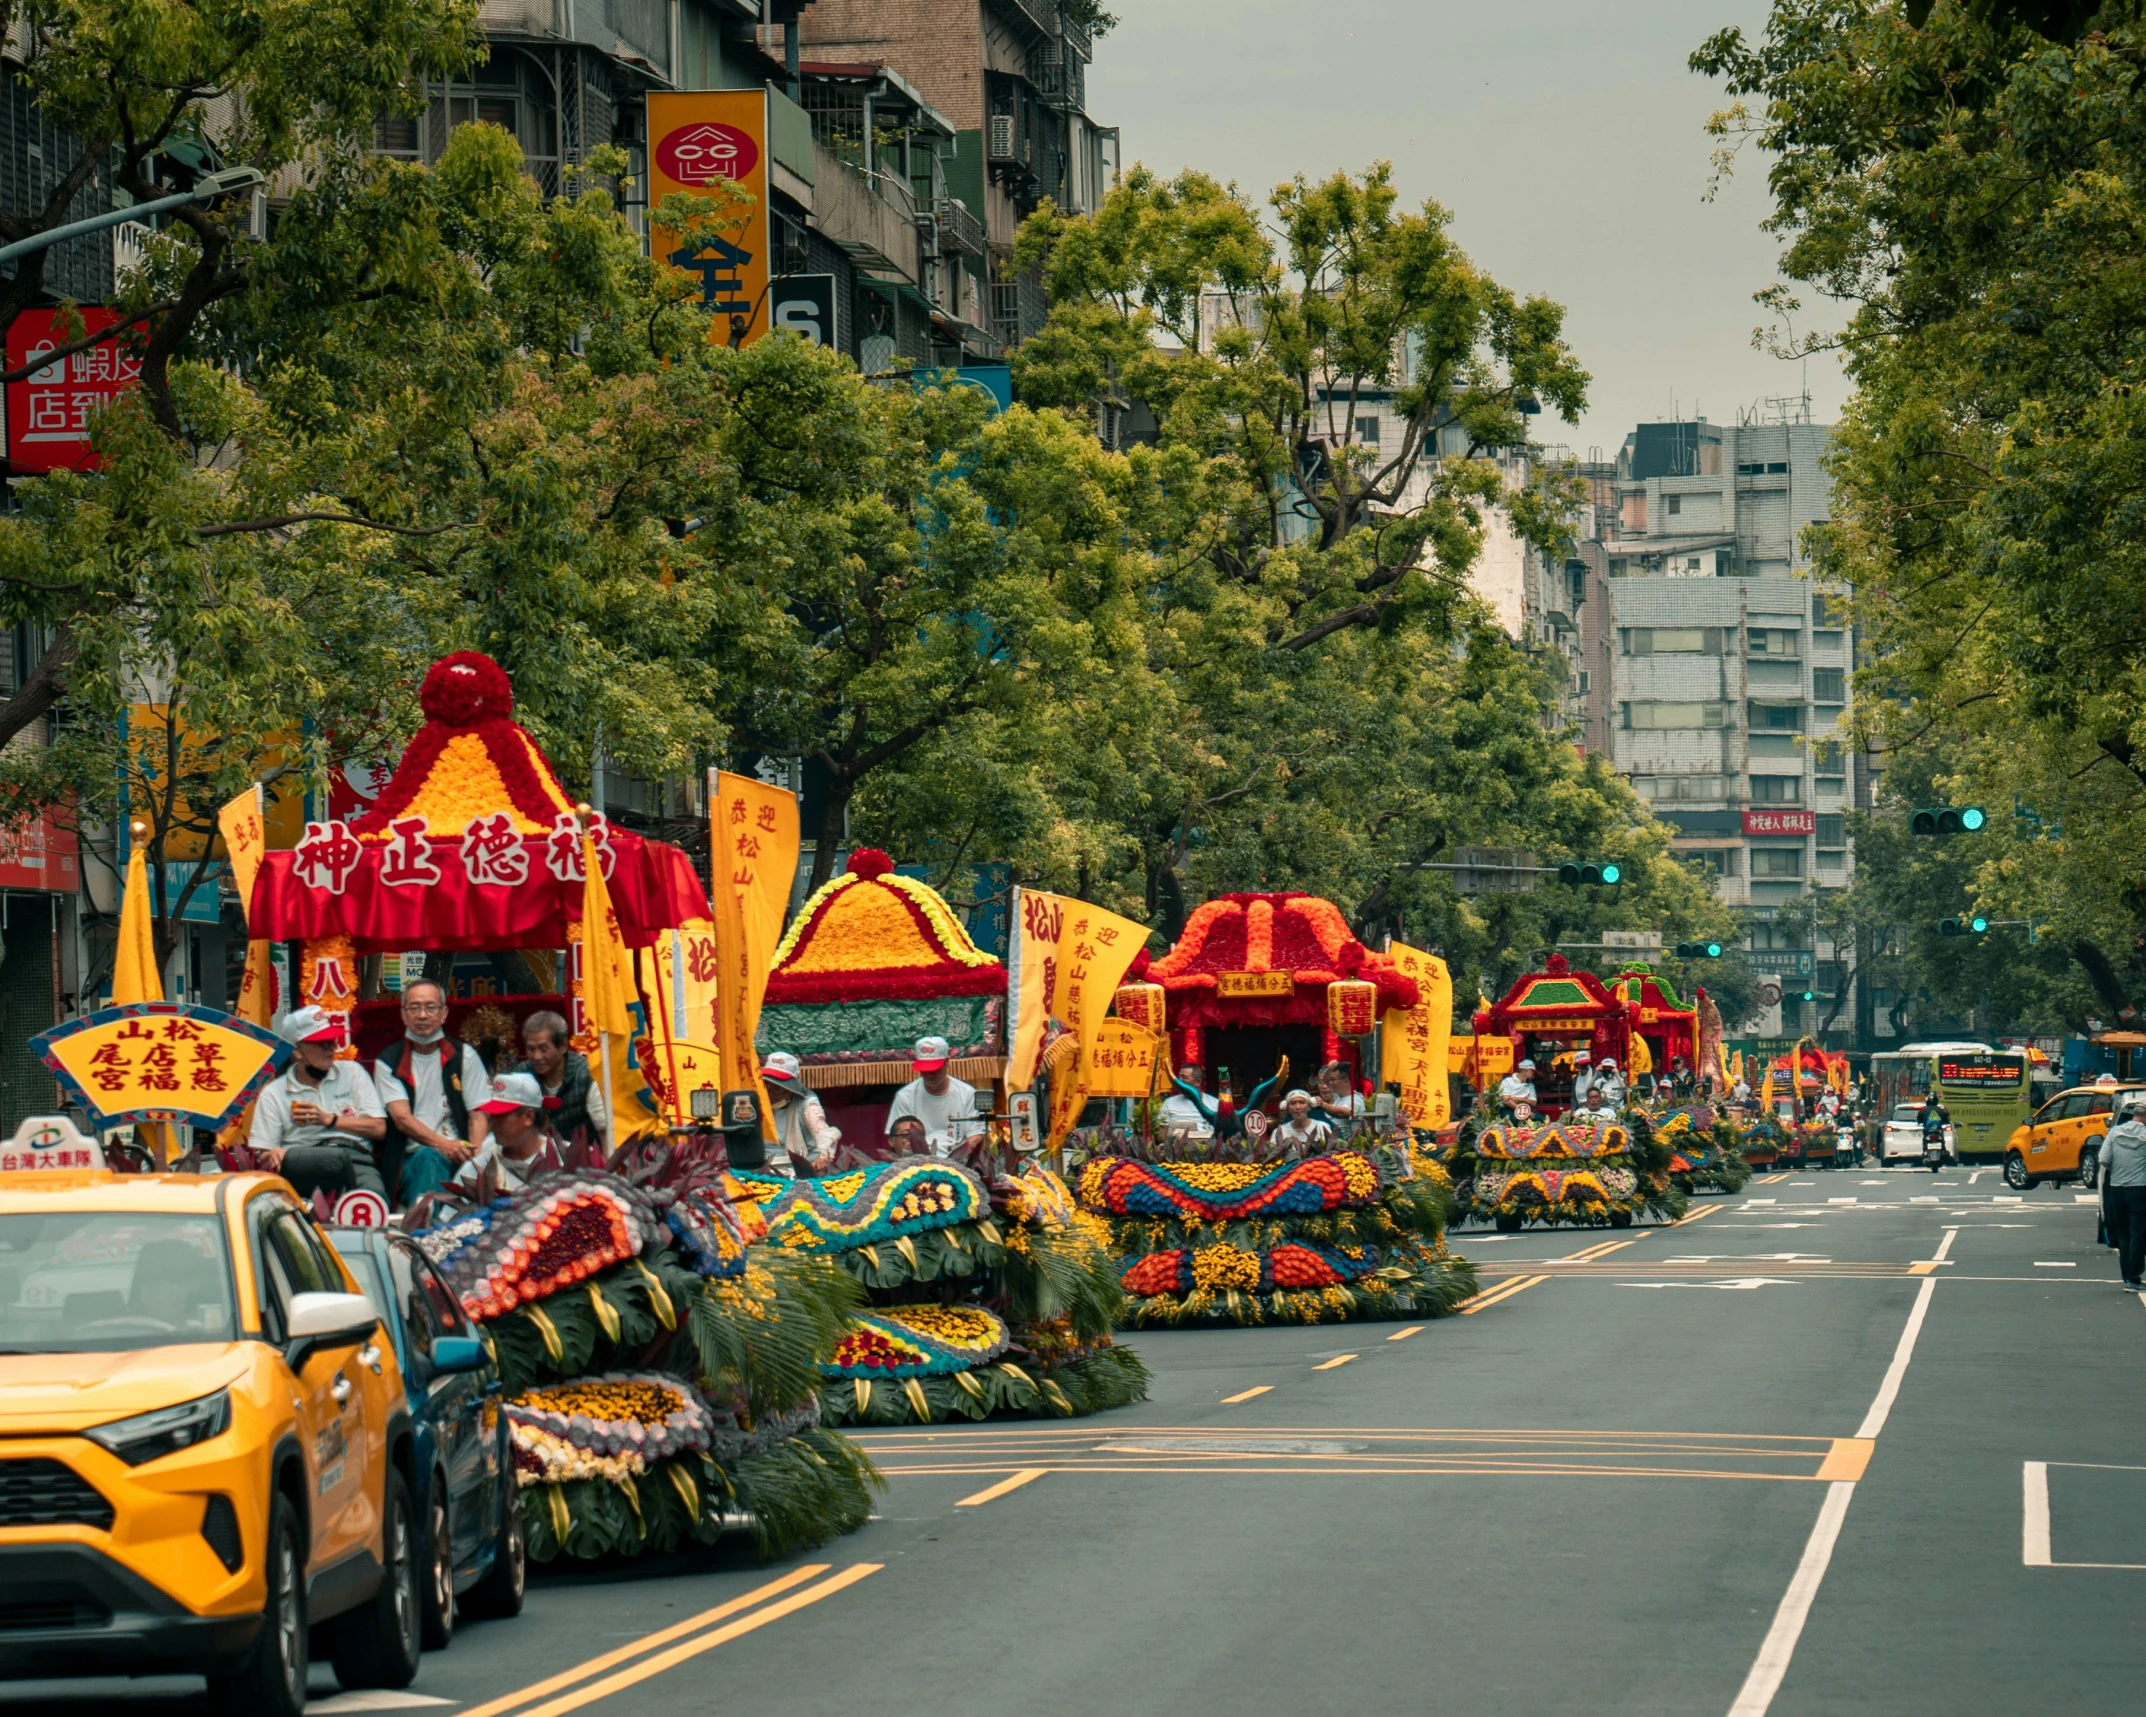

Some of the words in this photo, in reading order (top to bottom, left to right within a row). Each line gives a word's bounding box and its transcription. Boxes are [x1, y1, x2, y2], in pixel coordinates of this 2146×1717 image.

[29, 390, 146, 428] 店到
[731, 798, 777, 833] 恭迎
[1073, 918, 1119, 947] 恭迎
[1403, 956, 1440, 980] 恭迎
[1250, 1115, 1263, 1130] 10
[2, 1150, 92, 1170] 台灣大車隊
